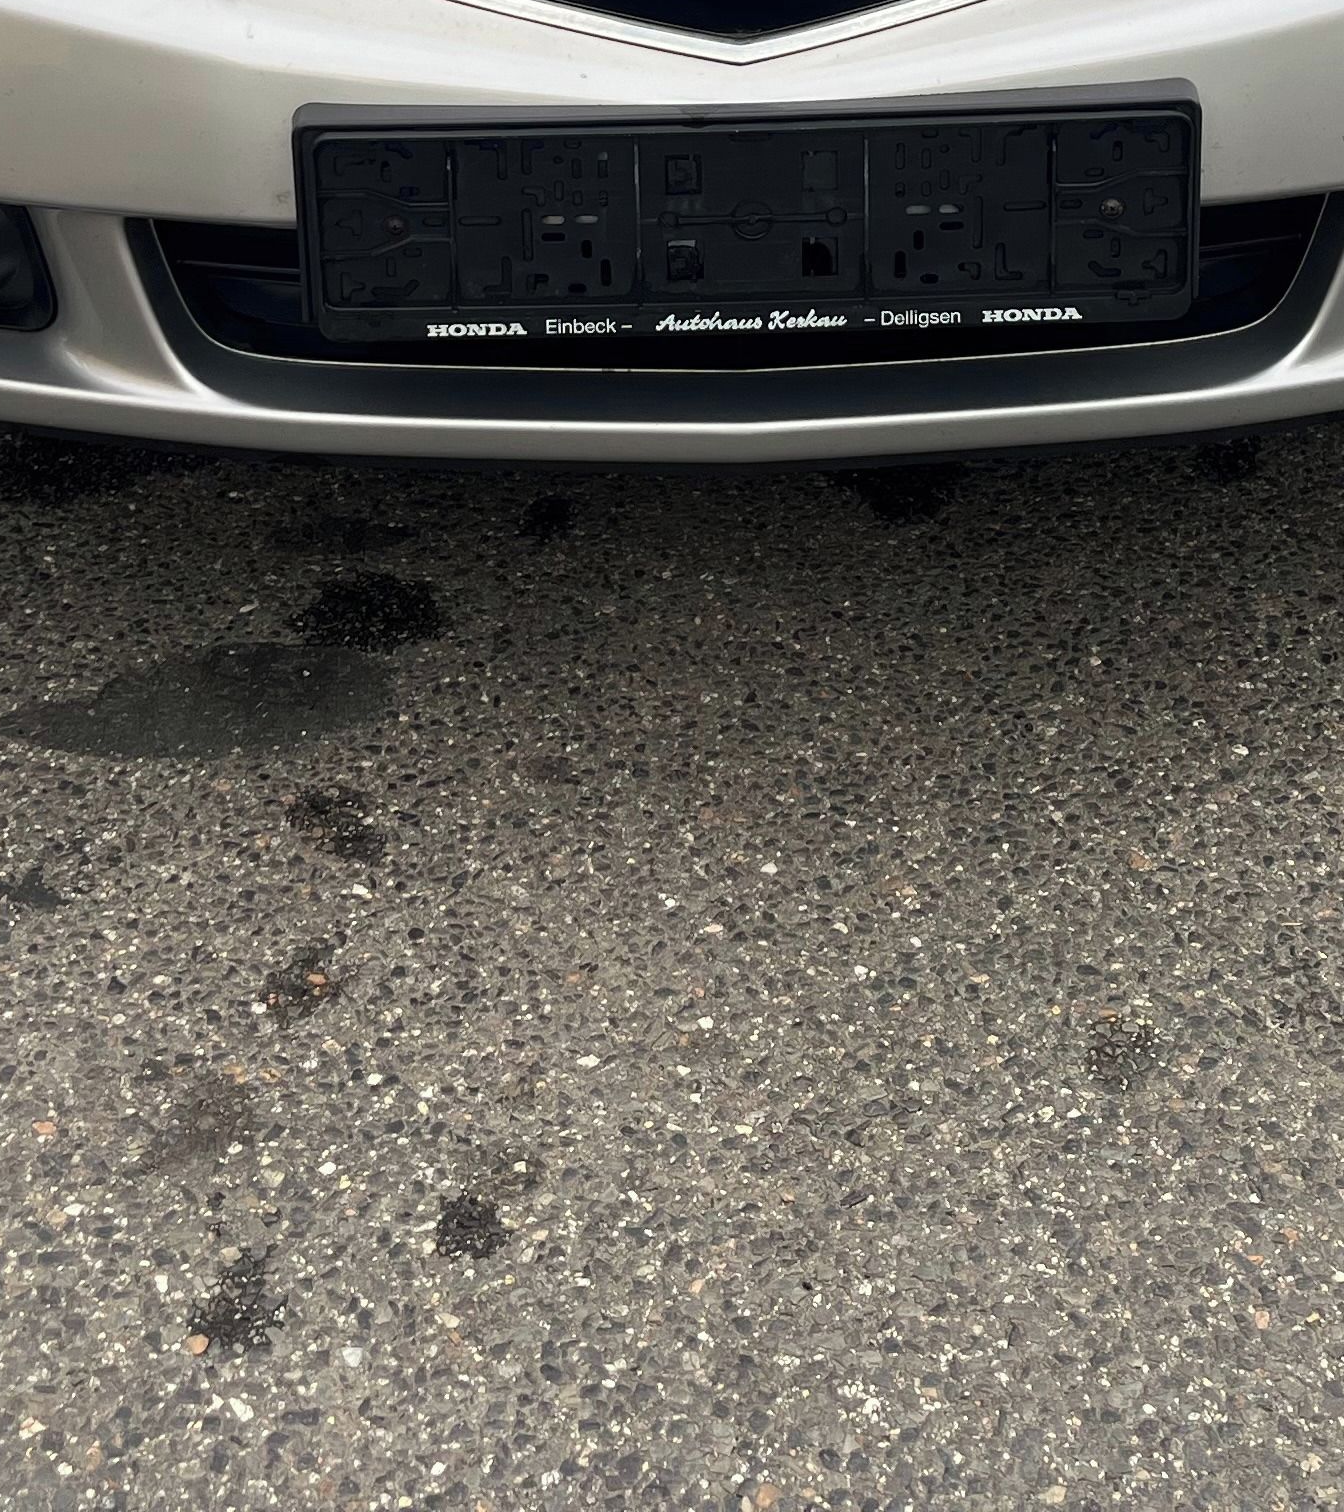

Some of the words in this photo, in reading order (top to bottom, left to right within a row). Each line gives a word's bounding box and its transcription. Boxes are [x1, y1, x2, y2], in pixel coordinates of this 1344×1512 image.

[427, 323, 527, 337] HONDA
[545, 319, 617, 334] Einbeck
[655, 311, 763, 332] Autohaus
[767, 308, 848, 331] Kerkau
[880, 309, 961, 328] Delligsen
[982, 307, 1082, 323] HONDA
